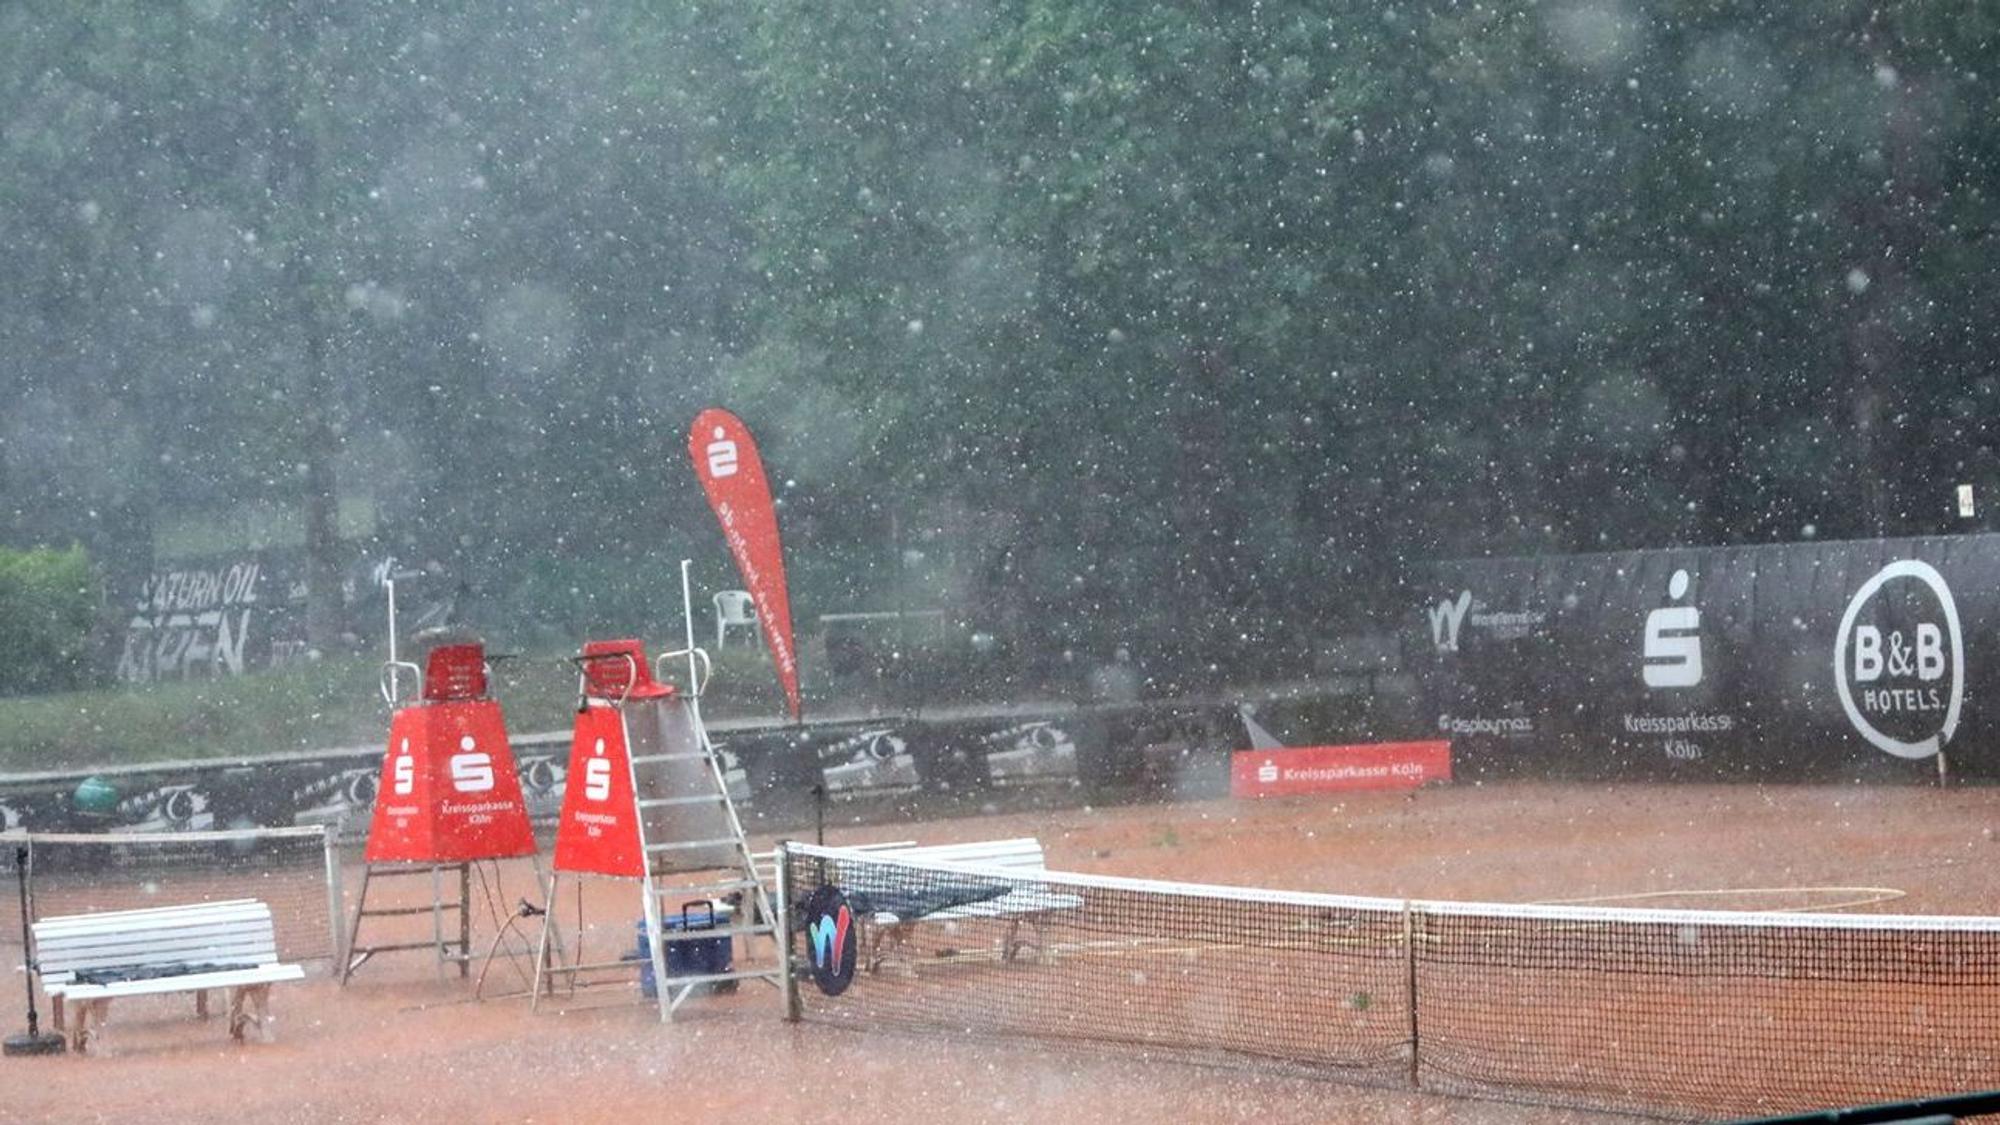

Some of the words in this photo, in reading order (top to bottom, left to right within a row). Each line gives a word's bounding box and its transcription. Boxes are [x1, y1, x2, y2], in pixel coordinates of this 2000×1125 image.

[136, 567, 225, 612] SATURN
[223, 562, 260, 605] OIL
[1854, 622, 1946, 682] B&B
[1283, 765, 1388, 783] Kreissparkasse
[1391, 761, 1424, 778] Köln
